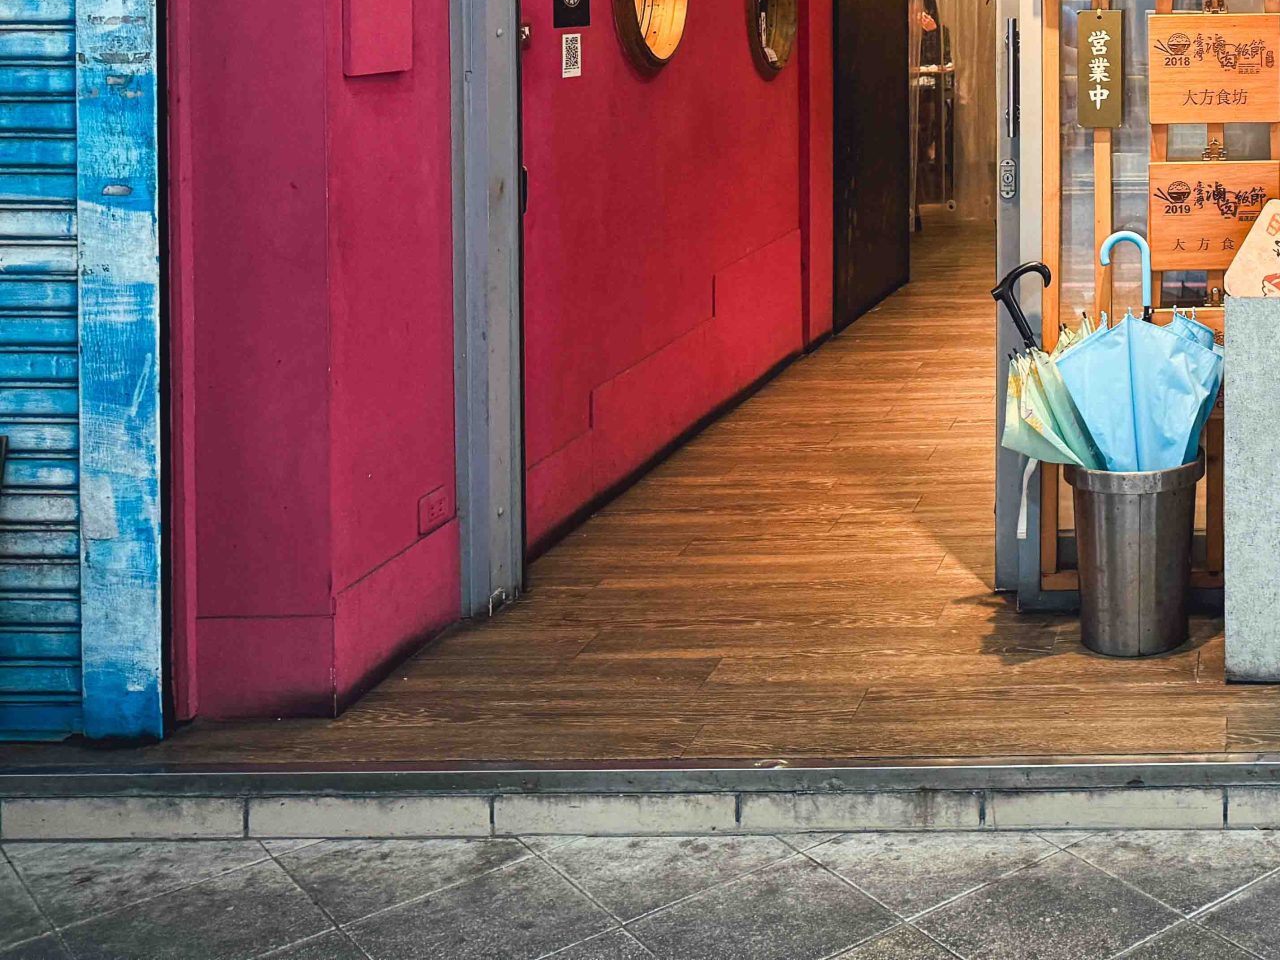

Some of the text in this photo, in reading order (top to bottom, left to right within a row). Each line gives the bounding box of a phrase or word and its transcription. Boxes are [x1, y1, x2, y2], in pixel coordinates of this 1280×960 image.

[1164, 56, 1191, 67] 2018
[1182, 88, 1248, 106] 大方食坊
[1164, 204, 1191, 215] 2019
